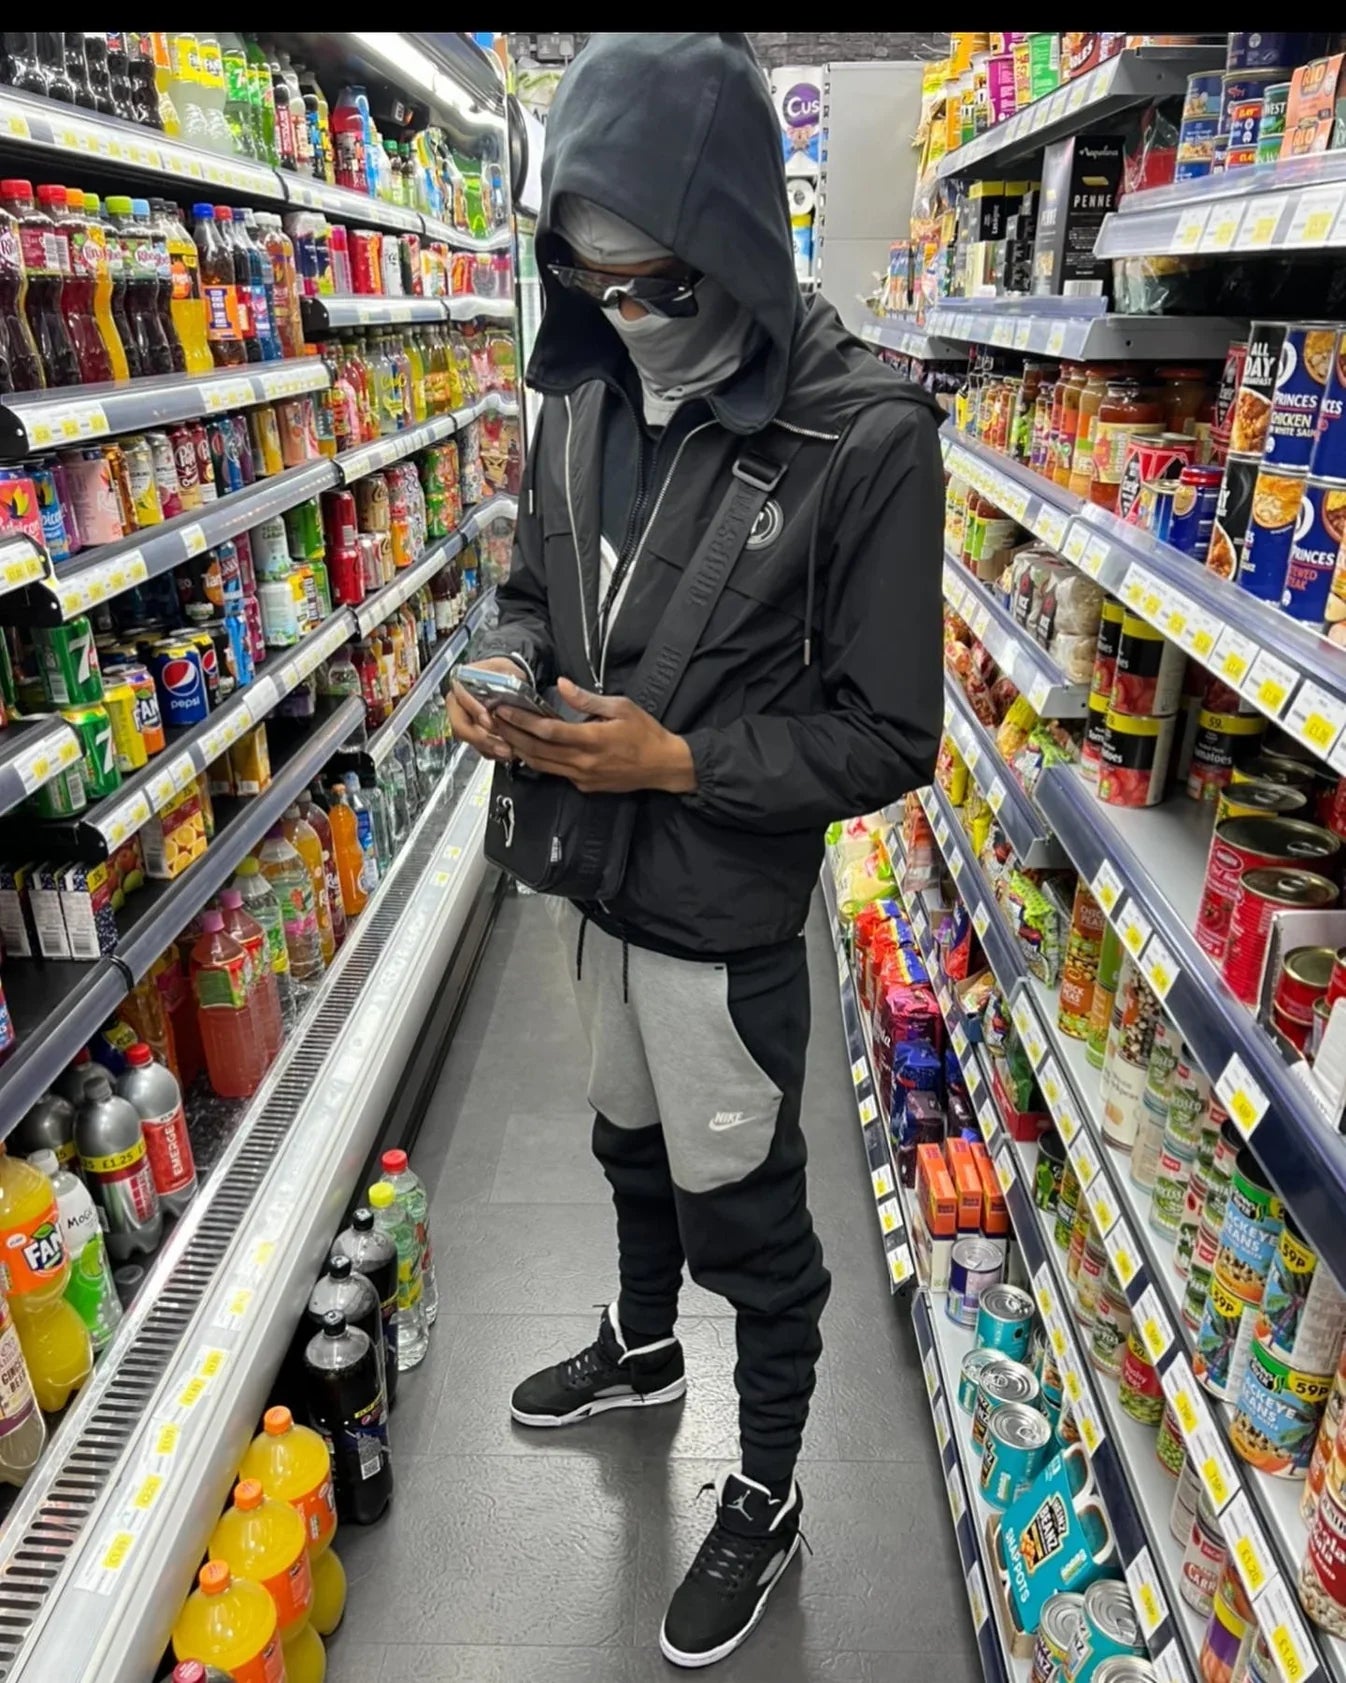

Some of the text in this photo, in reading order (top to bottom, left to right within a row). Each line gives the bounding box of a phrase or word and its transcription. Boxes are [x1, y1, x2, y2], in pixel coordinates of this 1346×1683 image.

[787, 96, 820, 116] Cus
[1073, 194, 1113, 208] PENNE
[1250, 341, 1270, 357] ALL
[1244, 356, 1276, 379] DAY
[1275, 394, 1319, 409] PRINCES
[1271, 412, 1313, 428] CHICKEN
[1291, 548, 1336, 570] PRINCES
[69, 634, 90, 684] 7
[170, 697, 201, 710] pepsi
[96, 726, 113, 775] 7
[713, 1111, 745, 1124] NIKE
[164, 1124, 184, 1177] EMERGE
[1282, 1243, 1306, 1269] 59P
[1213, 1290, 1235, 1313] 59P
[1295, 1381, 1329, 1397] 59P
[1040, 1504, 1058, 1552] BEANZ
[1005, 1527, 1030, 1603] SNAP POTS
